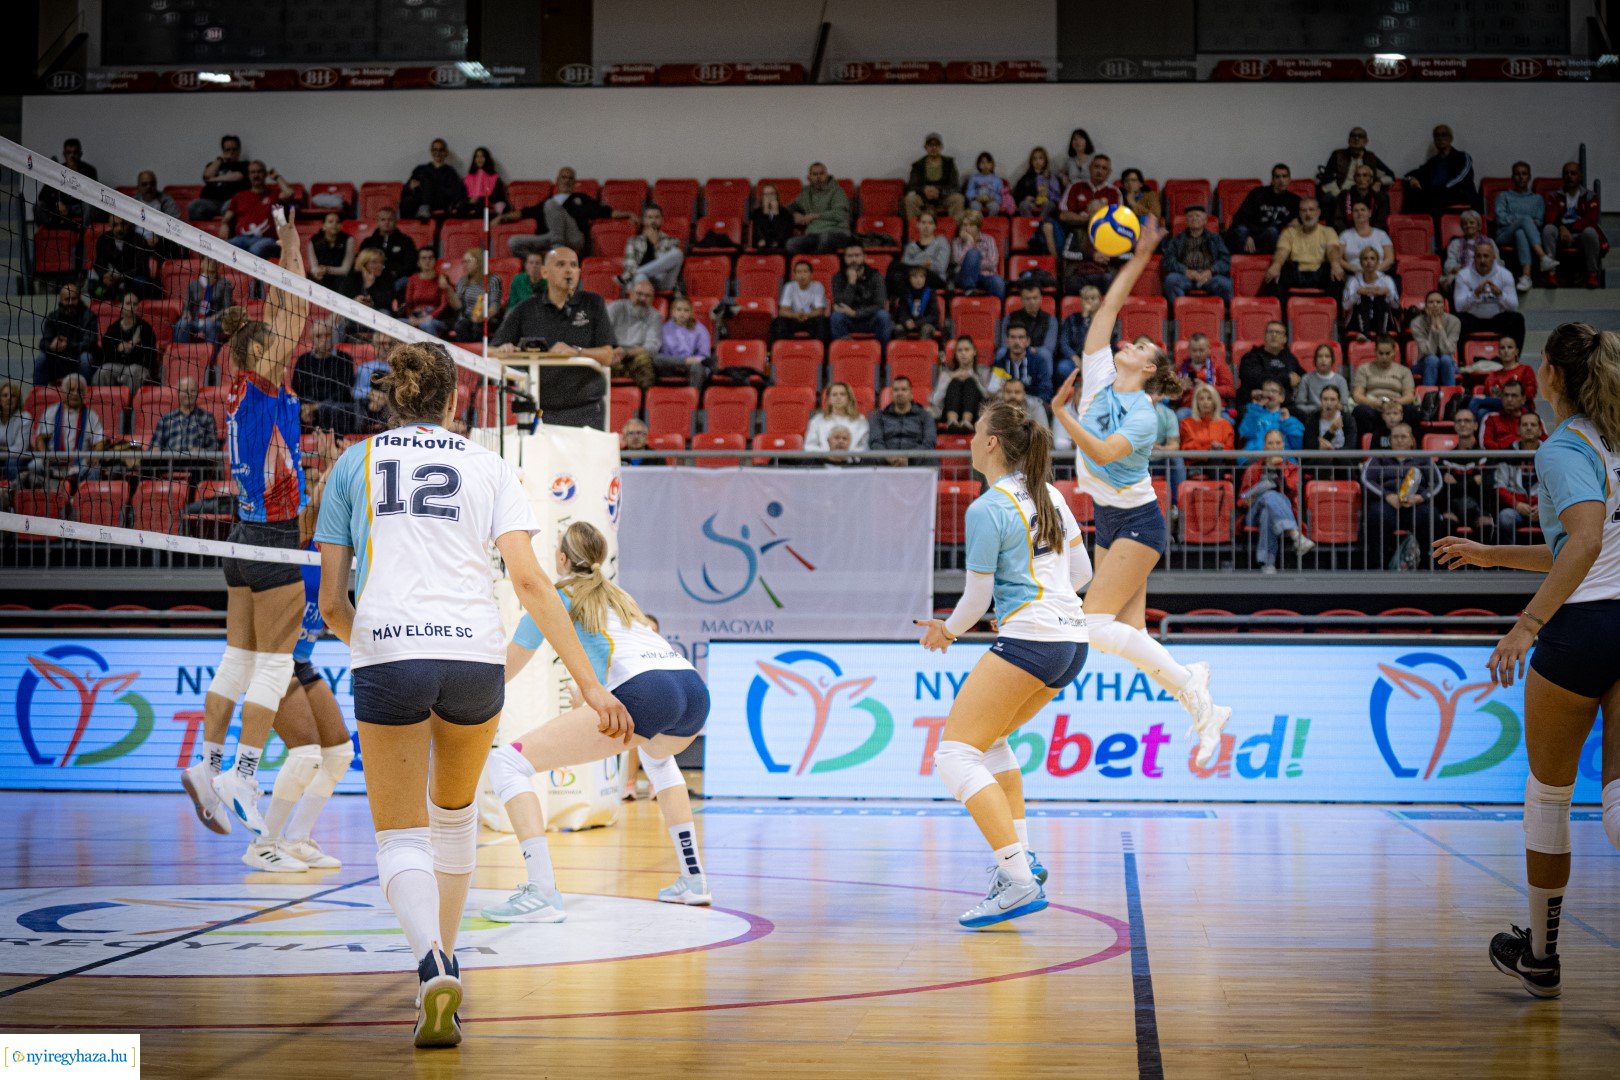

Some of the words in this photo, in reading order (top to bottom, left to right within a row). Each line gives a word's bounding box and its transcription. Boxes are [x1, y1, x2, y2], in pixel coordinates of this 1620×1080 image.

[971, 64, 995, 77] BH
[1105, 63, 1131, 76] BH
[1240, 62, 1265, 75] BH
[1277, 59, 1296, 69] Bige
[1298, 59, 1332, 68] Holding
[1411, 59, 1431, 69] Bige
[1433, 59, 1467, 68] Holding
[1509, 62, 1535, 75] BH
[309, 71, 331, 82] BH
[436, 70, 461, 82] BH
[563, 70, 590, 81] BH
[700, 67, 724, 80] BH
[1286, 69, 1321, 77] Csoport
[1421, 68, 1456, 77] Csoport
[375, 434, 466, 452] Marković
[375, 458, 462, 521] 12
[373, 624, 402, 641] MÁV
[406, 622, 453, 638] ELŐRE
[456, 626, 474, 639] SC
[702, 620, 775, 634] MAGYAR
